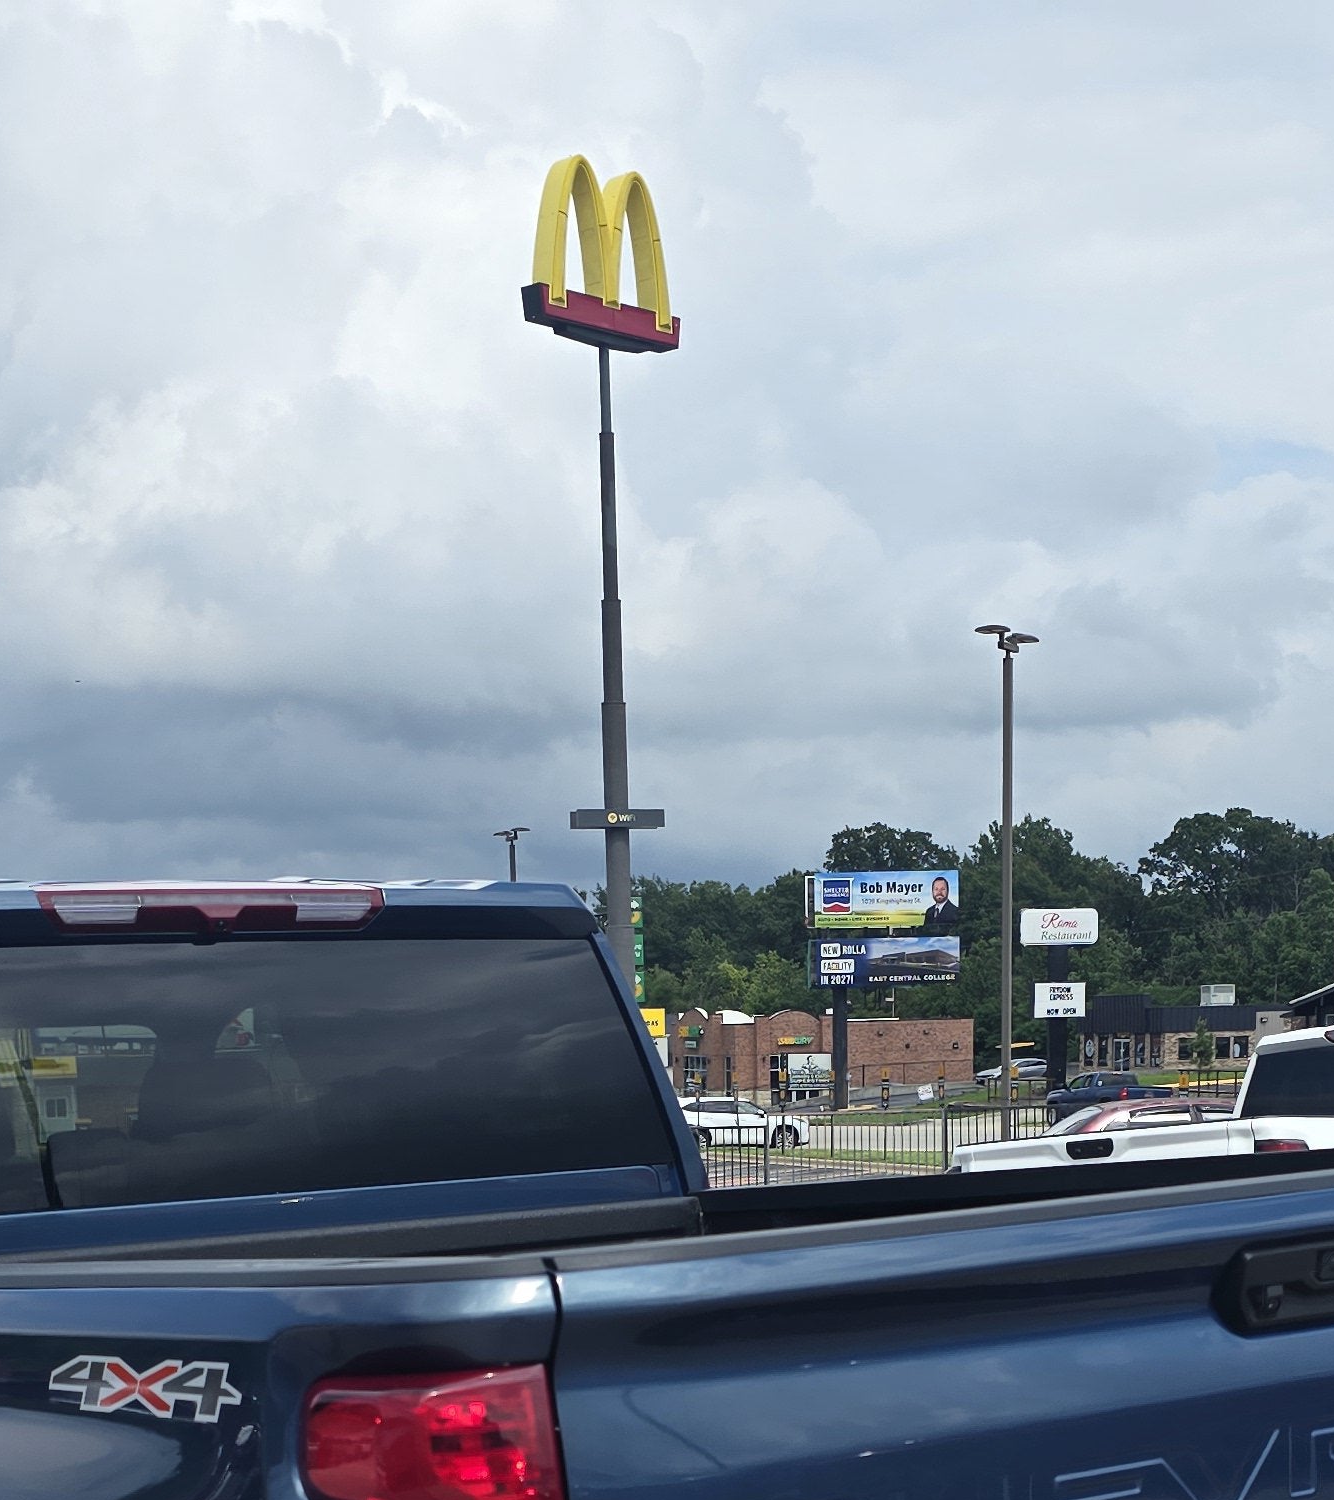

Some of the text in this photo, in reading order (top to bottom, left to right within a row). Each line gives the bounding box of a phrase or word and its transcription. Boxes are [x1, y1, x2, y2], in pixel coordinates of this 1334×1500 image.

[860, 881, 924, 896] Bob Mayer
[1041, 930, 1092, 941] Restaurant
[823, 944, 866, 955] NEW ROLLA
[889, 974, 921, 982] CENTRAL
[923, 973, 956, 981] COLLEGE
[1049, 993, 1074, 1001] EXPRESS
[1062, 1007, 1077, 1015] OPEN
